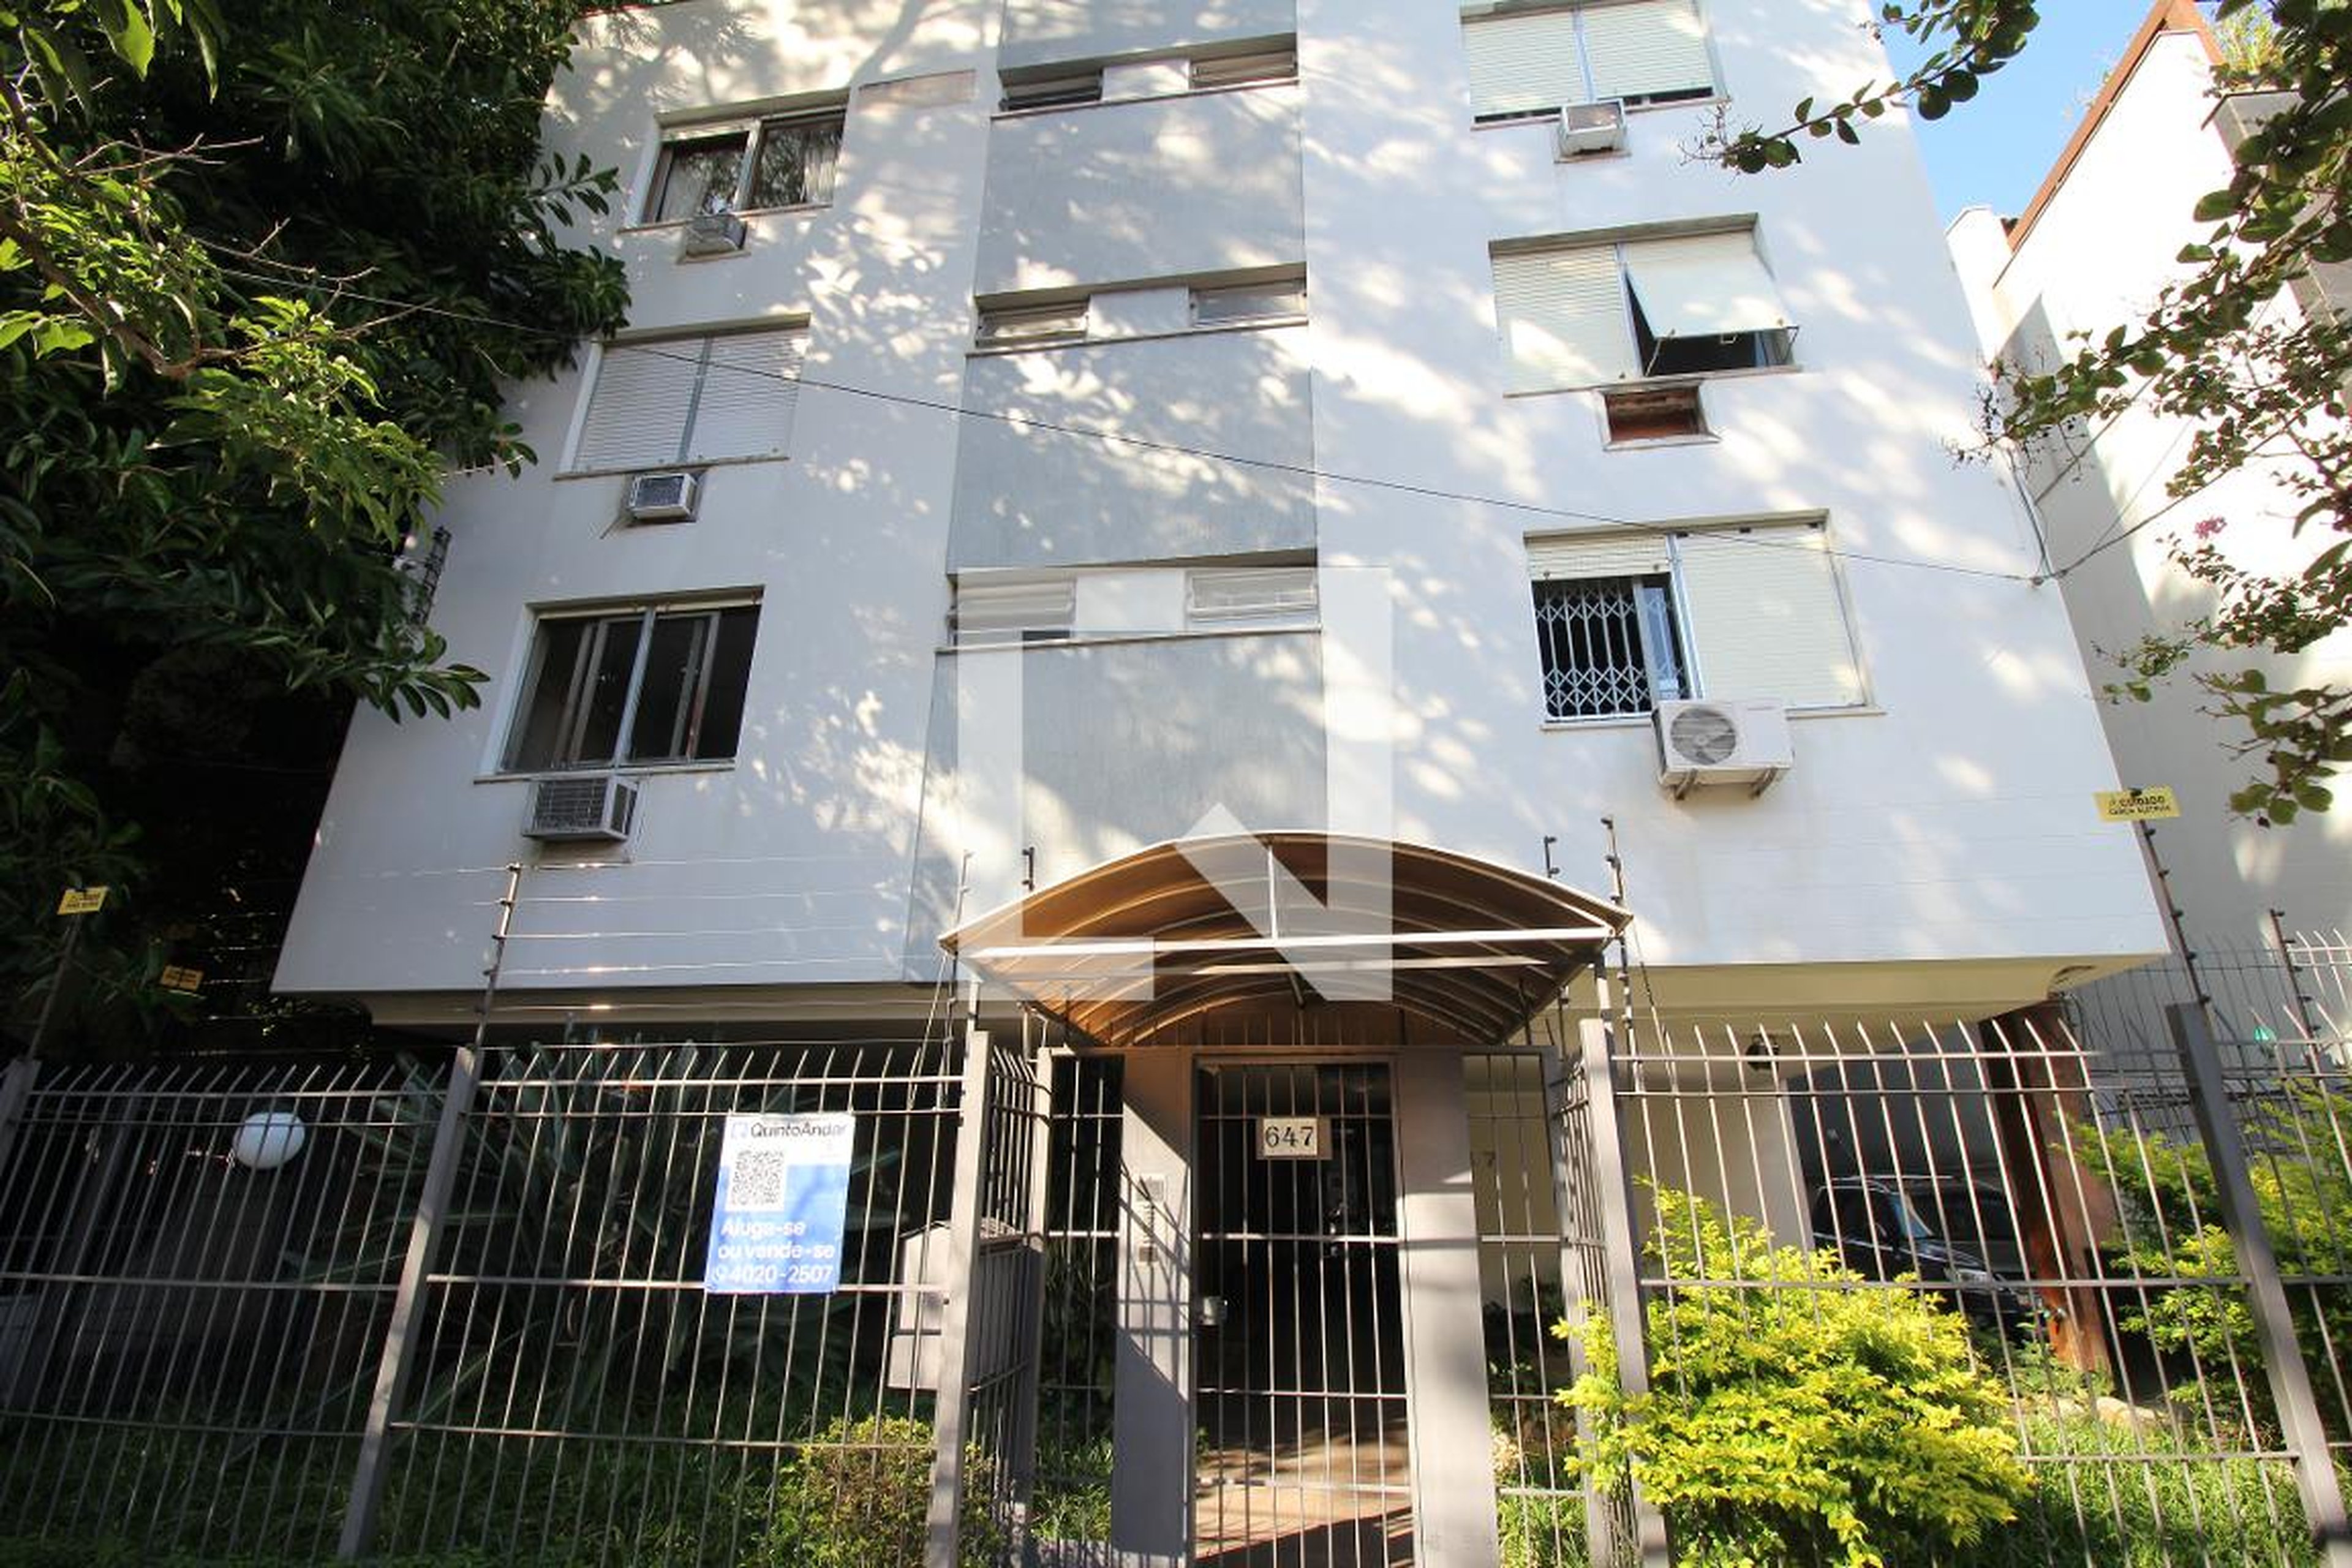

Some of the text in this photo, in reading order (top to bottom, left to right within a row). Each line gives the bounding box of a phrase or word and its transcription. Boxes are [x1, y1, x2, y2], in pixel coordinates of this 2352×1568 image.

[750, 1121, 846, 1138] QuintoAndar
[1265, 1126, 1314, 1148] 647
[720, 1218, 805, 1238] Aluga-se
[718, 1245, 741, 1259] ou
[732, 1264, 834, 1284] 4020-2507
